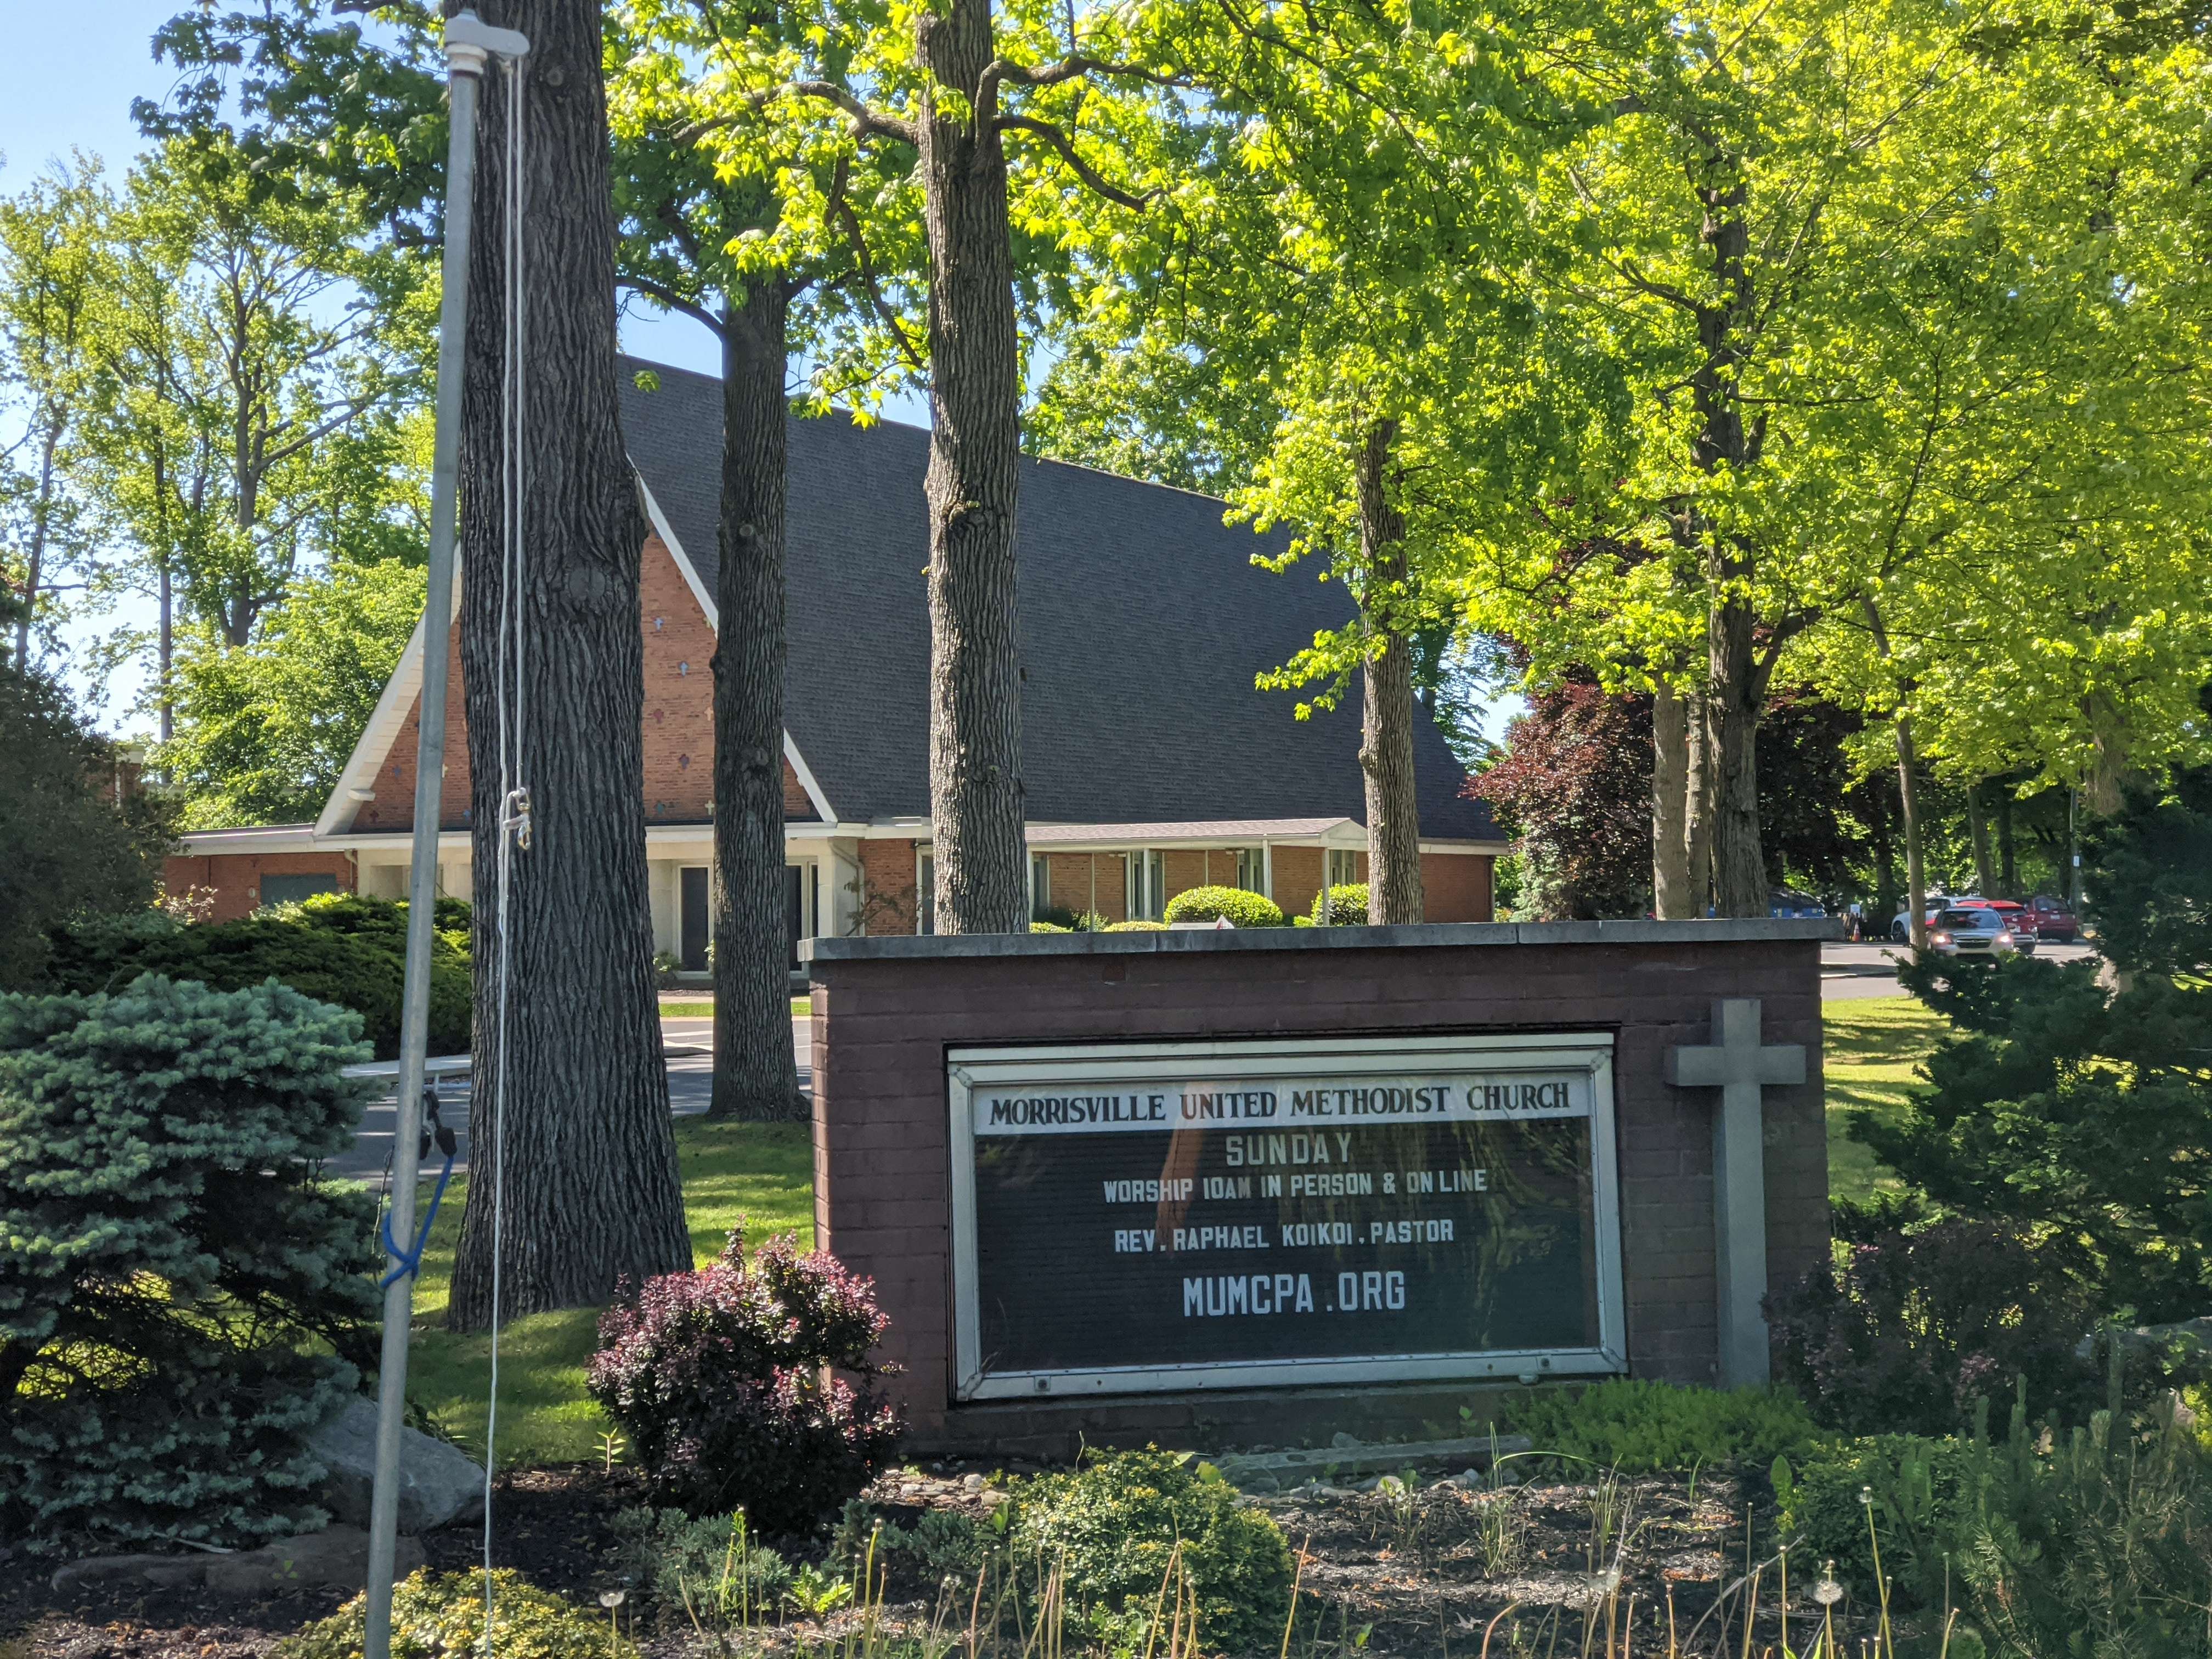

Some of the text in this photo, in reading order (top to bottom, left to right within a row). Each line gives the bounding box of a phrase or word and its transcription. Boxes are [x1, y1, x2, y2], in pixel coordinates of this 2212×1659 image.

[989, 1082, 1570, 1126] MORRISVILLE UNITED METHODIST CHURCH
[1226, 1132, 1351, 1166] SUNDAY
[1103, 1178, 1193, 1203] WORSHIP
[1261, 1175, 1282, 1197] IN
[1290, 1172, 1372, 1197] PERSON
[1383, 1172, 1396, 1194] &
[1173, 1226, 1269, 1251] RAPHAEL
[1370, 1219, 1454, 1244] PASTOR
[1183, 1273, 1314, 1317] MUMCPA
